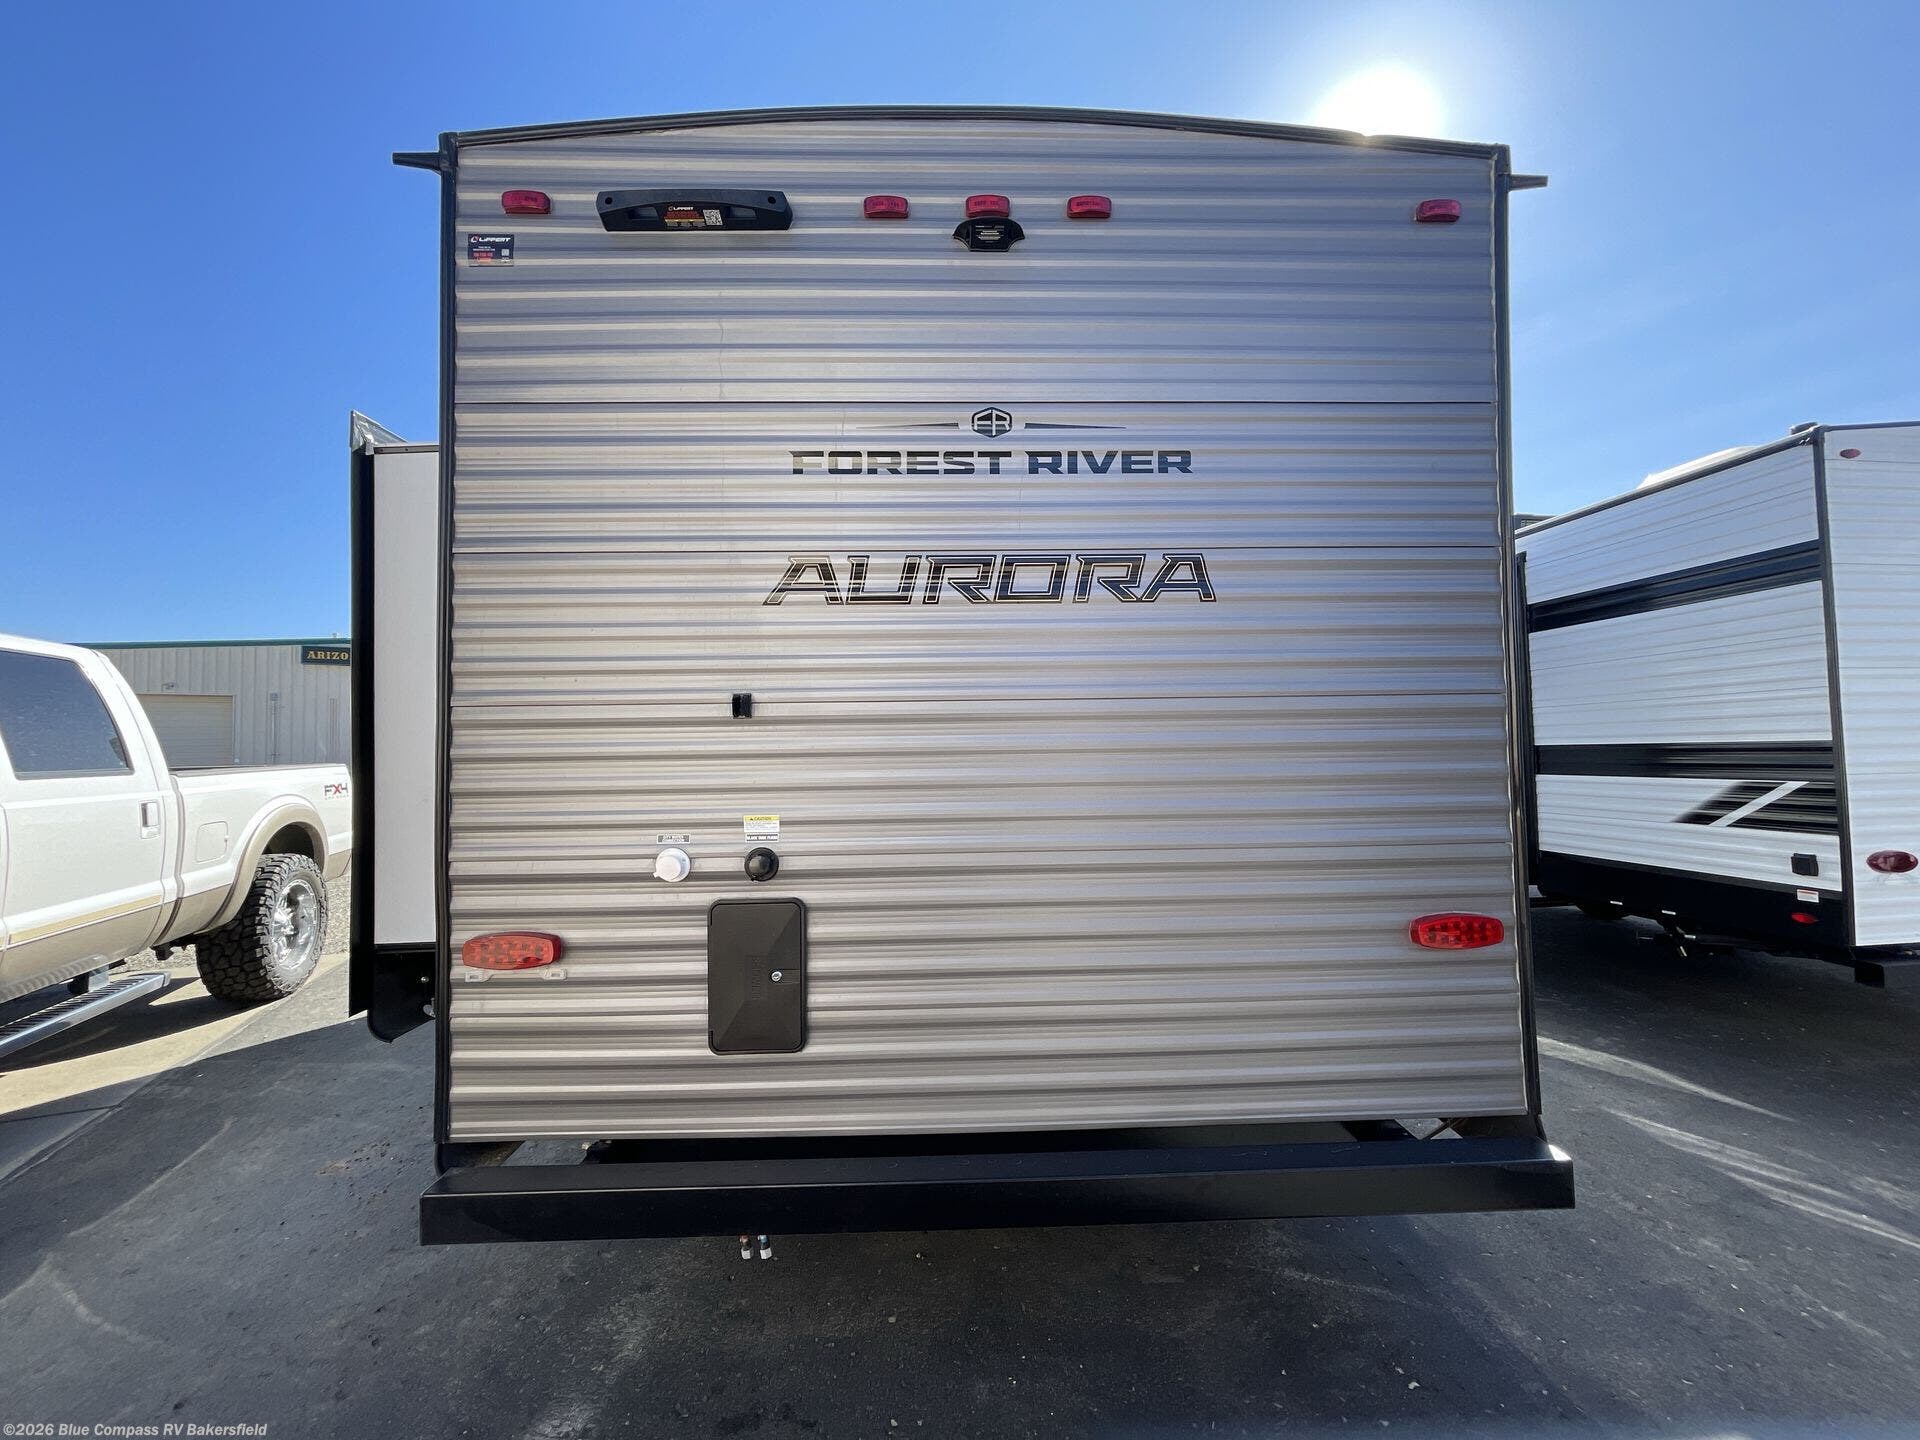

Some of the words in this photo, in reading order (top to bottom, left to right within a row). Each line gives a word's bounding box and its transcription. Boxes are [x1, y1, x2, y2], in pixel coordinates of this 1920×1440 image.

[788, 450, 1012, 475] FOREST
[1024, 450, 1194, 475] RIVER
[762, 553, 1217, 605] AURORA
[306, 650, 349, 660] ARIZO
[323, 783, 349, 796] FX4
